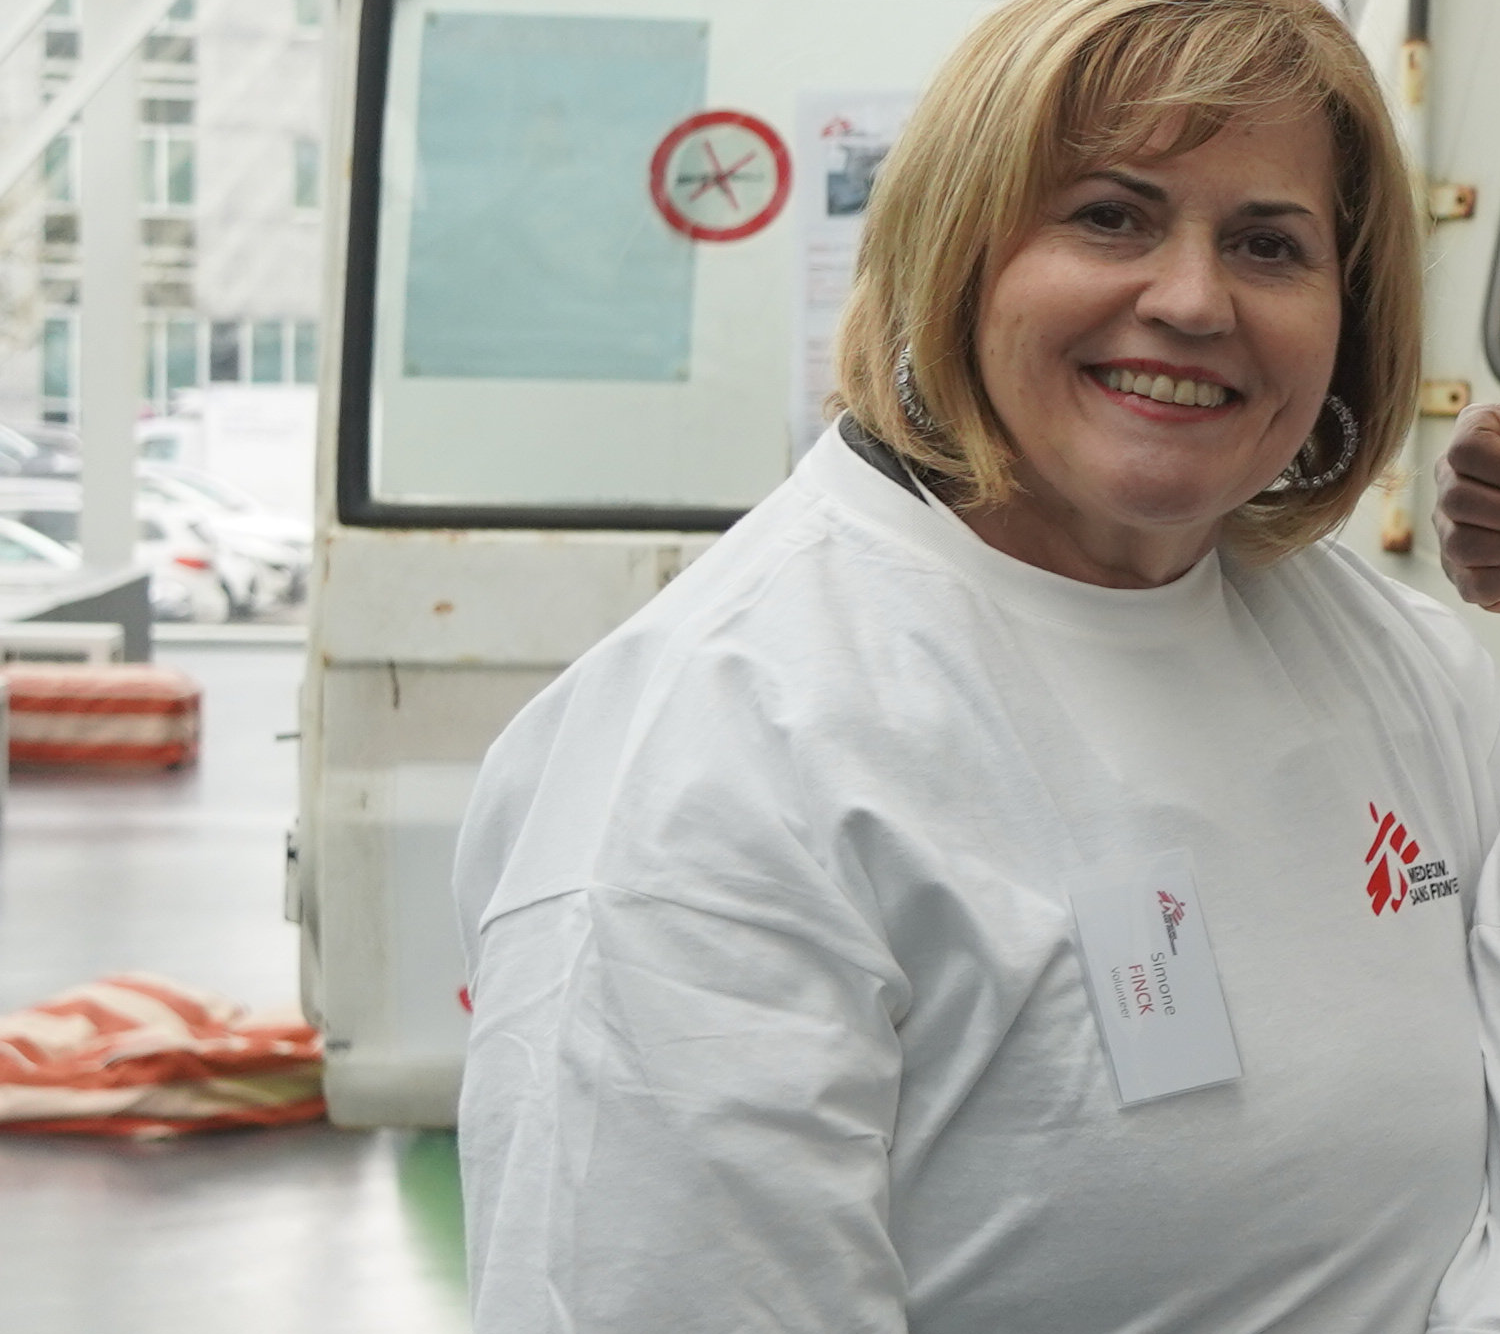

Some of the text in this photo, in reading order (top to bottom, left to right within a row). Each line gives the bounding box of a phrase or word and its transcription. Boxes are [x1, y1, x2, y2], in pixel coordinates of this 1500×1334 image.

[1110, 966, 1131, 1020] Volunteer
[1129, 964, 1155, 1016] FINCK
[1150, 952, 1176, 1016] Simone
